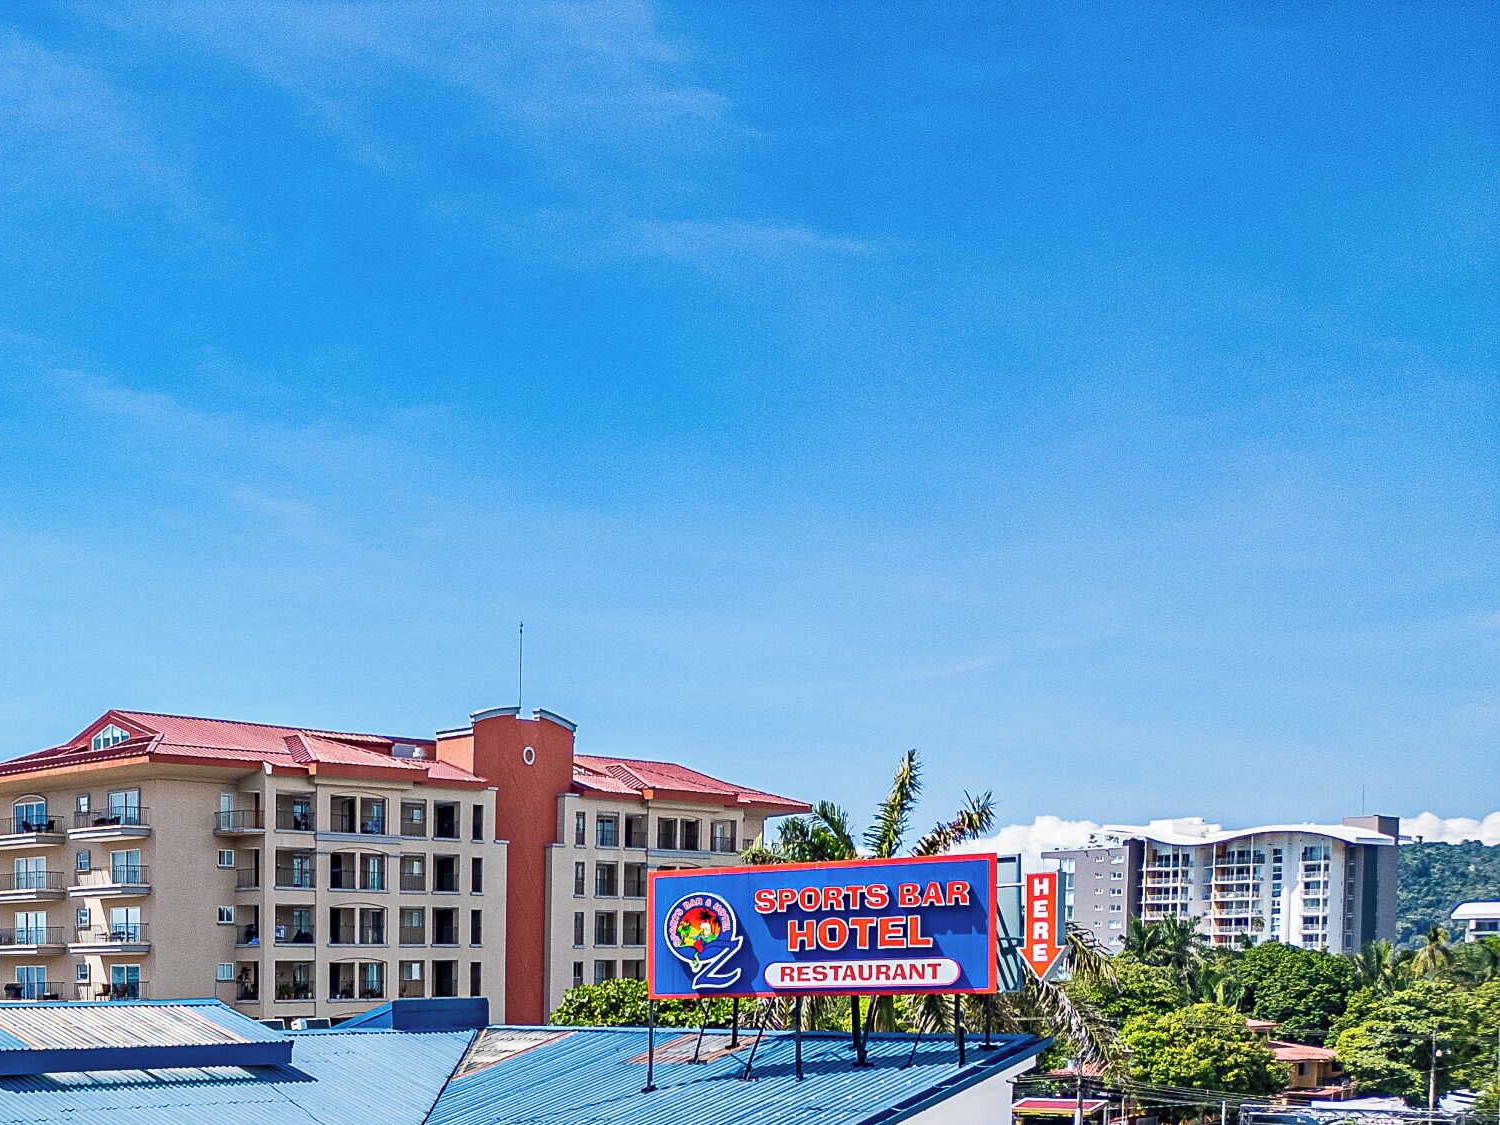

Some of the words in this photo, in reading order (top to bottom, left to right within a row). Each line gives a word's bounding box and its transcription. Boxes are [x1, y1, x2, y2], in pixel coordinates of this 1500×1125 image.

[755, 884, 889, 914] SPORTS
[899, 880, 970, 908] BAR
[669, 908, 684, 947] SPORTS
[683, 897, 703, 910] BAR
[713, 902, 731, 932] HOTEL
[788, 915, 933, 952] HOTEL
[1032, 877, 1049, 962] HERE
[780, 962, 942, 982] RESTAURANT
